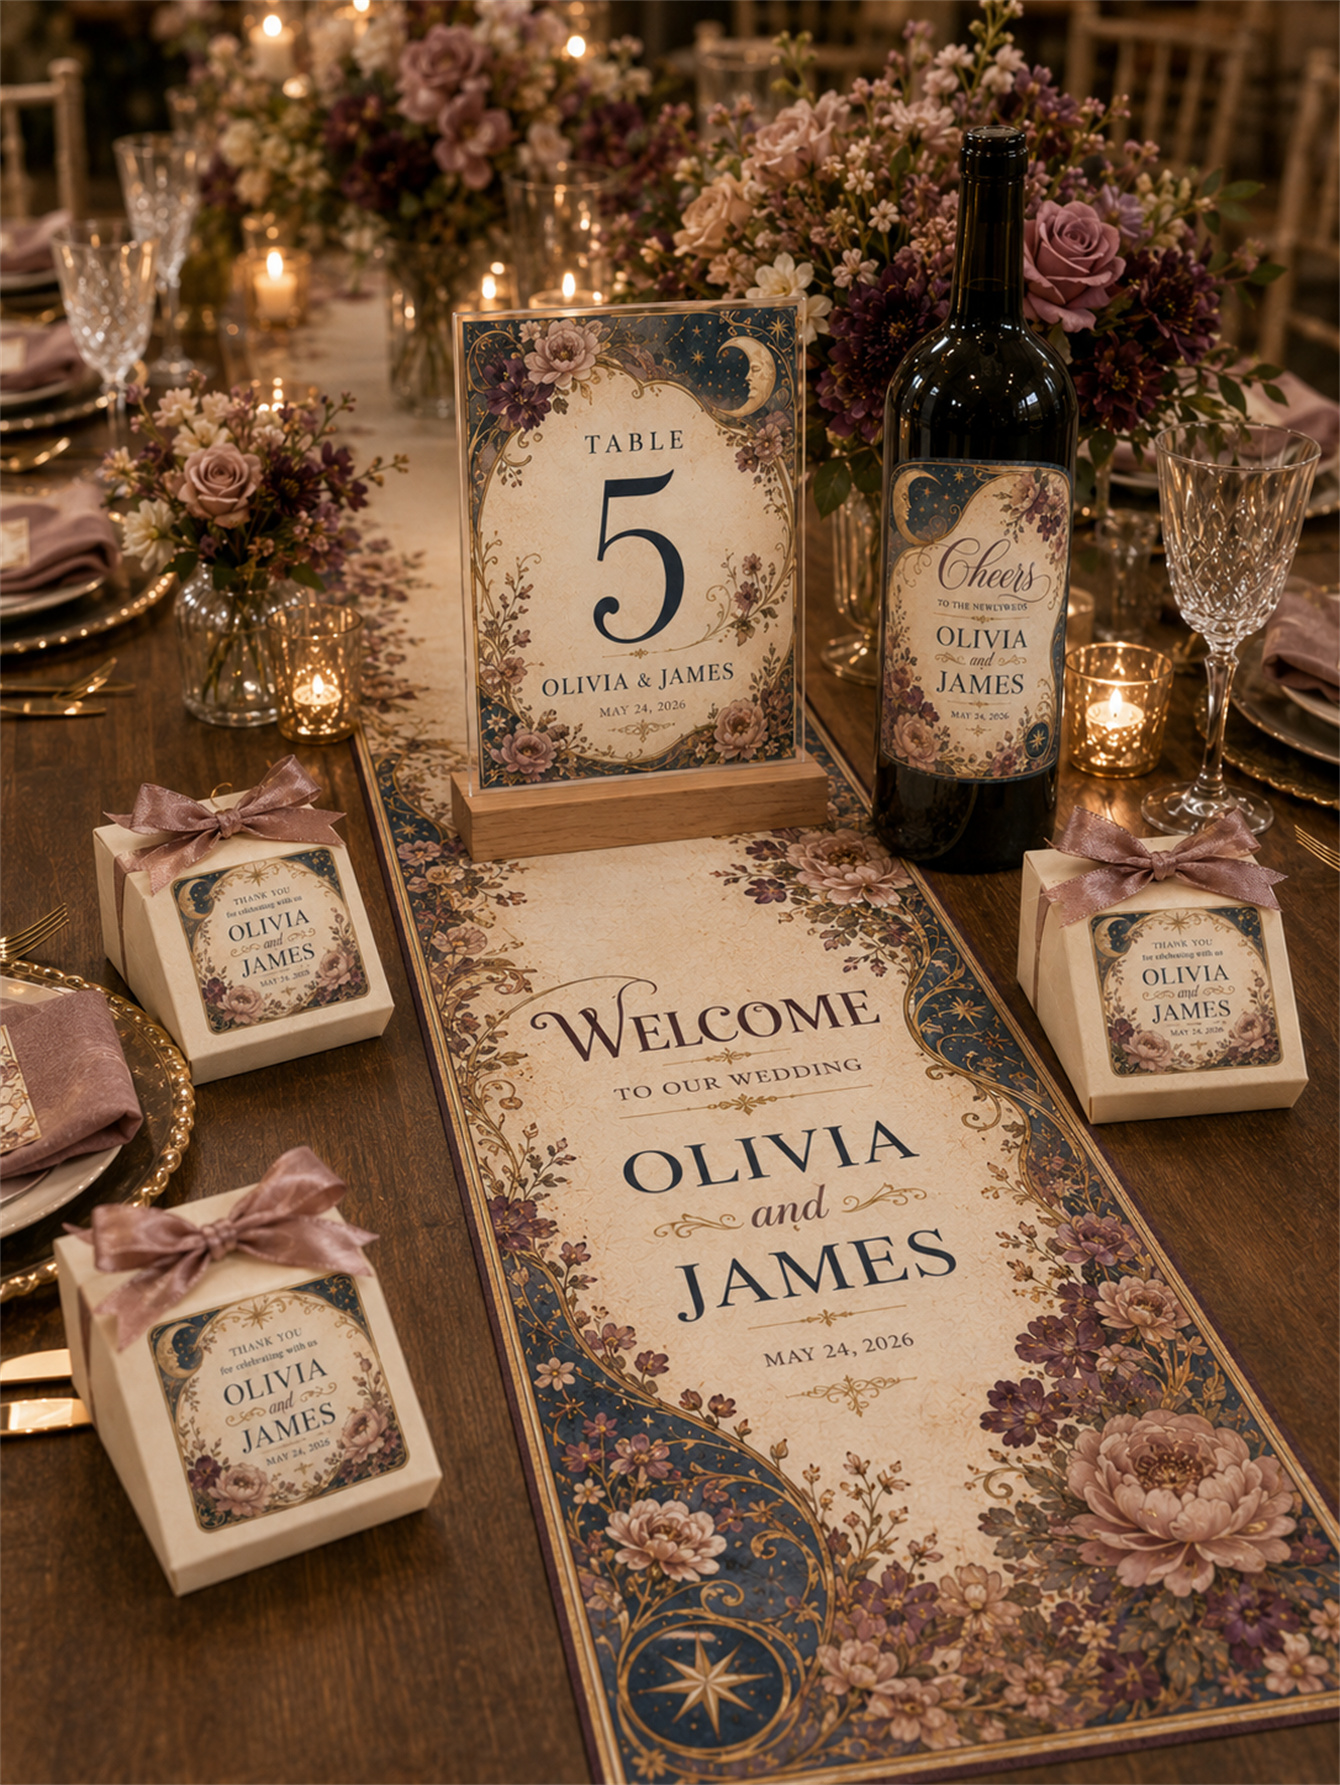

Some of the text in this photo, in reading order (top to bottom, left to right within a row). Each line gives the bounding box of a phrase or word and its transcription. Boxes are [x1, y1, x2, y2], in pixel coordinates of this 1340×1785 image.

[584, 429, 684, 454] TABLE
[593, 468, 685, 644] 5
[938, 537, 1051, 603] Cheers
[937, 599, 949, 608] TO
[952, 600, 970, 611] THE
[936, 625, 1028, 649] OLIVIA
[969, 652, 995, 667] and
[541, 662, 735, 697] OLIVIA & JAMES
[936, 670, 1025, 695] JAMES
[599, 699, 686, 718] MAY 24, 2026
[233, 886, 290, 905] THANK YOU
[228, 909, 310, 943] OLIVIA
[263, 932, 284, 950] and
[1152, 938, 1213, 949] THANK YOU
[241, 942, 316, 979] JAMES
[1142, 963, 1230, 987] OLIVIA
[1177, 985, 1199, 998] and
[530, 978, 881, 1063] WELCOME
[1152, 999, 1231, 1024] JAMES
[613, 1057, 864, 1101] TO OUR WEDDING
[622, 1119, 920, 1194] OLIVIA
[751, 1184, 830, 1229] and
[675, 1228, 958, 1322] JAMES
[228, 1328, 302, 1357] THANK YOU
[763, 1332, 915, 1368] MAY 24, 2026
[223, 1358, 328, 1406] OLIVIA
[268, 1390, 295, 1415] and
[242, 1401, 336, 1454] JAMES
[266, 1452, 289, 1466] MAY
